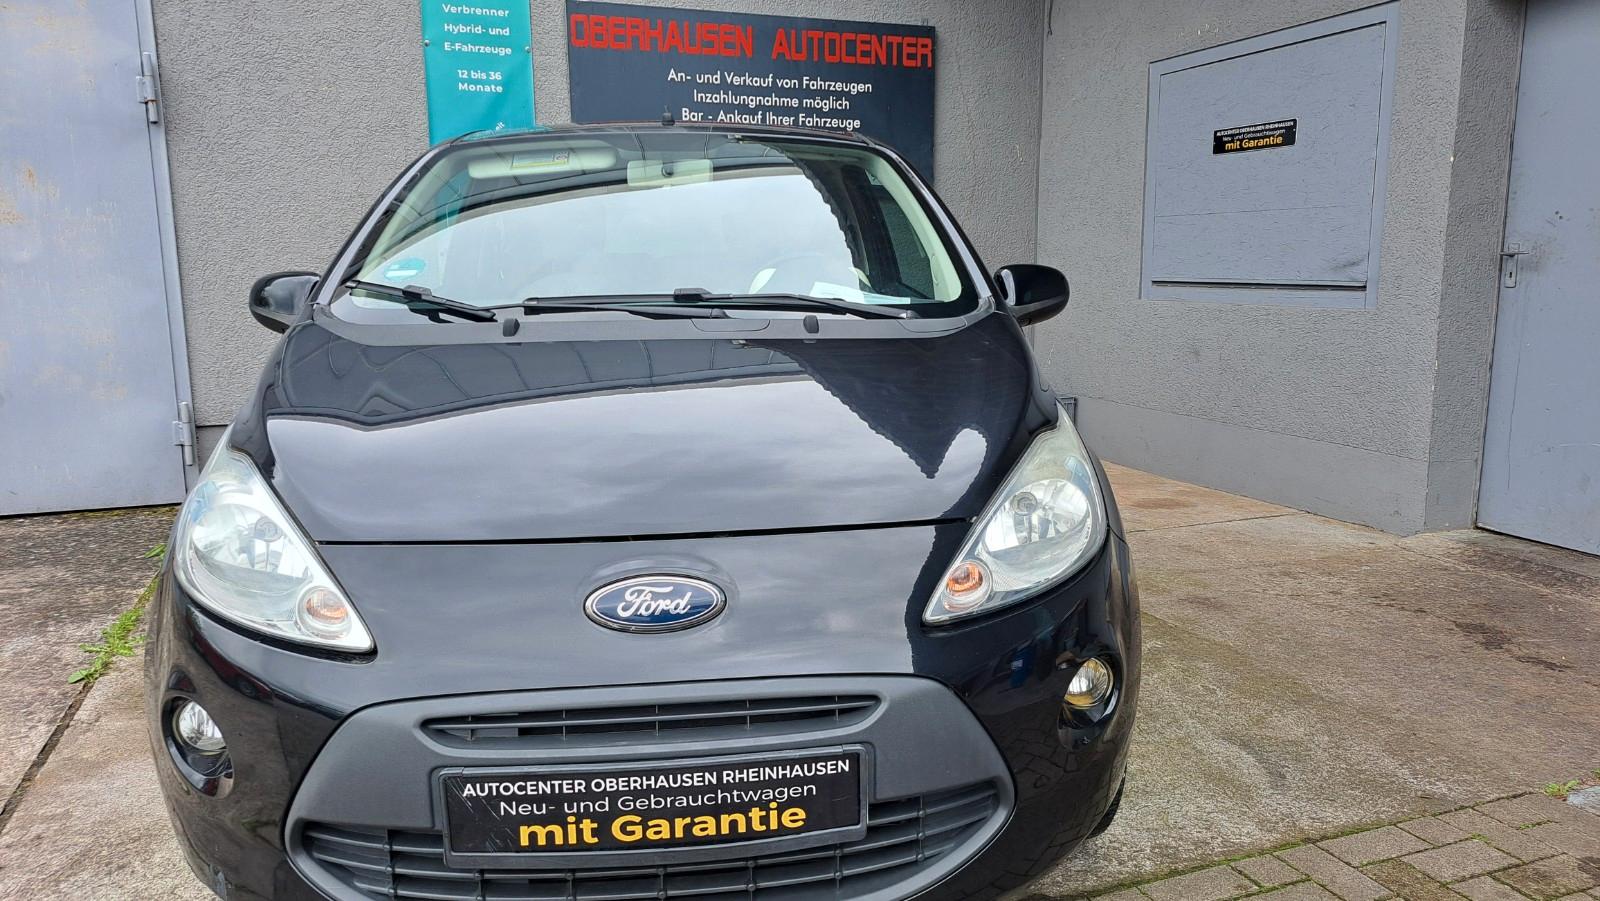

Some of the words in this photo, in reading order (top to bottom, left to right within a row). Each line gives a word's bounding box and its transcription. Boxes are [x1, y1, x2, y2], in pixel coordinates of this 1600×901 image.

[442, 3, 510, 17] Verbrenner
[444, 23, 486, 35] Hybrid-
[488, 26, 510, 36] und
[570, 13, 753, 59] OBERHAUSEN
[771, 28, 933, 69] AUTOCENTER
[444, 42, 512, 56] E-Fahrzeuge
[457, 69, 469, 79] 12
[470, 70, 487, 80] bis
[488, 71, 502, 81] 36
[667, 67, 692, 82] An-
[696, 70, 721, 85] und
[724, 71, 774, 88] Verkauf
[776, 78, 799, 89] von
[802, 76, 873, 95] Fahrzeugen
[458, 82, 503, 93] Monate
[693, 89, 799, 108] Inzahlungnahme
[802, 96, 850, 112] möglich
[681, 107, 704, 122] Bar
[716, 109, 763, 125] Ankauf
[766, 112, 796, 126] Ihrer
[799, 113, 861, 131] Fahrzeuge
[1225, 140, 1240, 150] mit
[1242, 135, 1283, 148] Garantie
[616, 585, 693, 618] Ford
[462, 778, 586, 798] AUTOCENTER
[591, 771, 718, 792] OBERHAUSEN
[722, 758, 850, 783] RHEINHAUSEN
[499, 799, 556, 816] Neu-
[563, 797, 609, 814] und
[614, 782, 817, 811] Gebrauchtwagen
[519, 815, 599, 847] mit
[611, 801, 807, 842] Garantie
